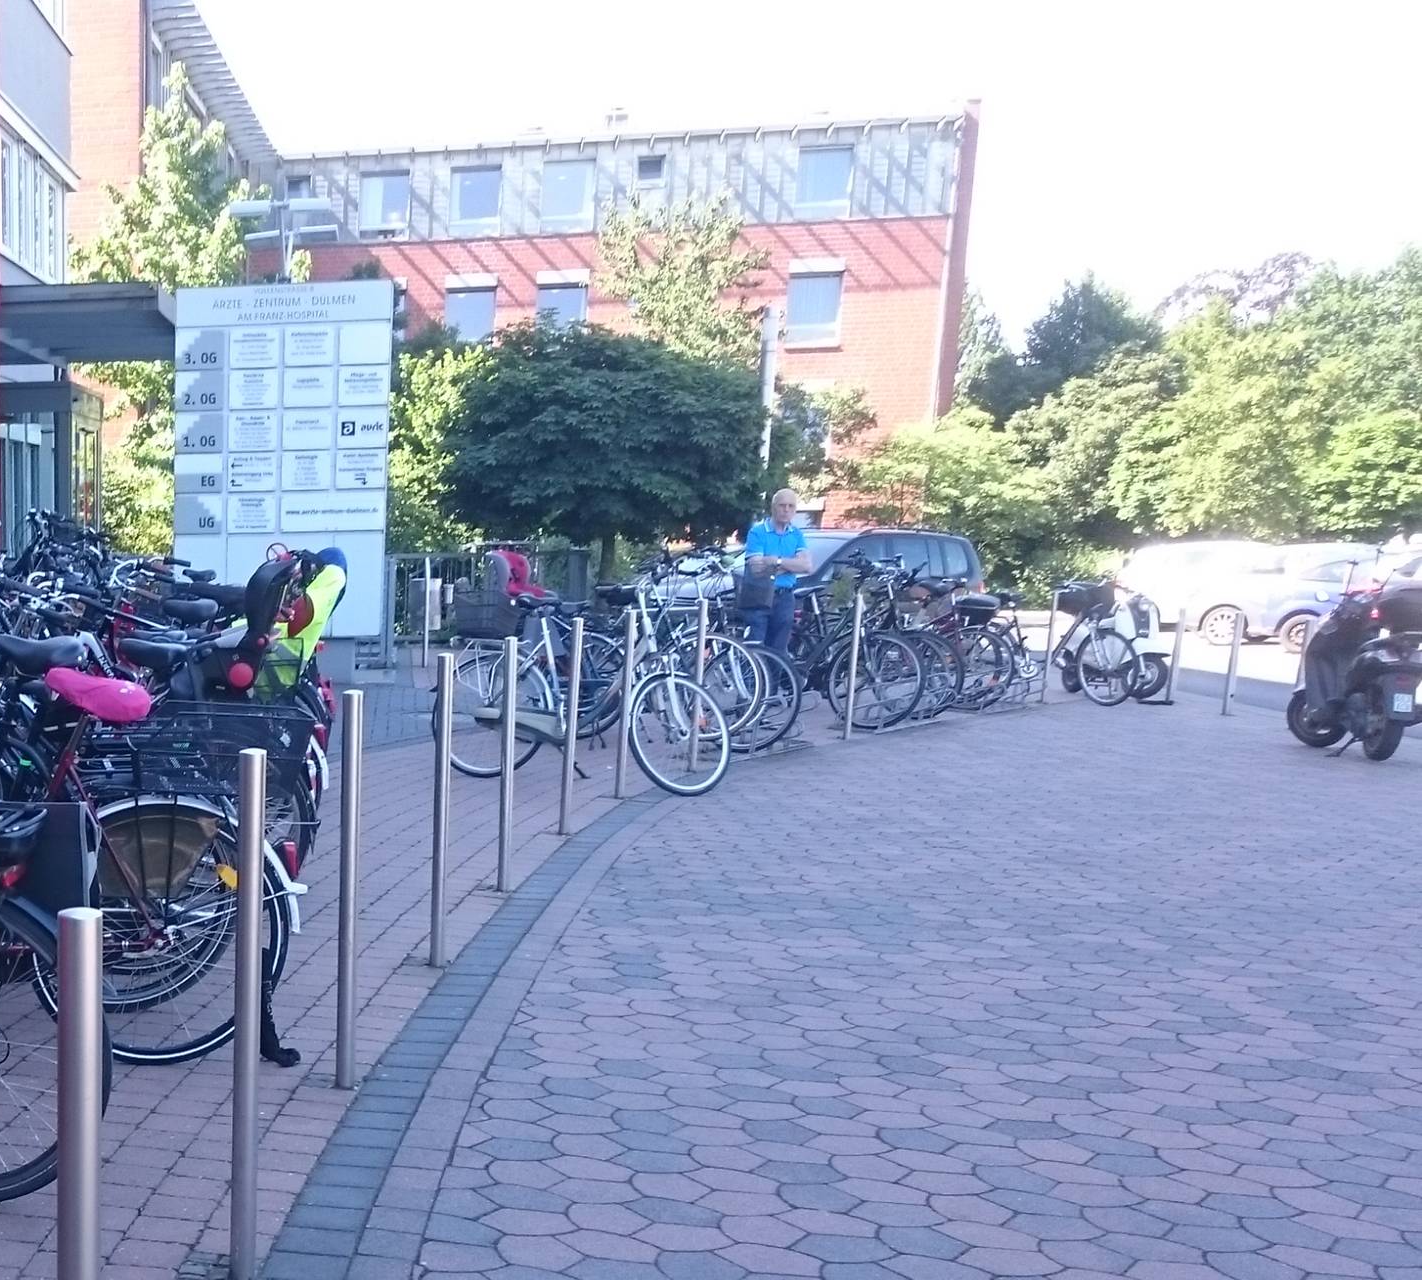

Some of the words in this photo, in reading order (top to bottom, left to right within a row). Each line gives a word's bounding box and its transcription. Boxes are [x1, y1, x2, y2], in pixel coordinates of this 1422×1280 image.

[253, 297, 301, 308] ZENTRUM
[237, 312, 253, 322] AM
[184, 353, 196, 364] 3.
[200, 352, 217, 364] OG
[184, 393, 196, 405] 2.
[200, 392, 217, 405] OG
[183, 436, 195, 447] 1.
[199, 435, 216, 447] OG
[200, 475, 215, 487] EG
[198, 517, 214, 528] UG
